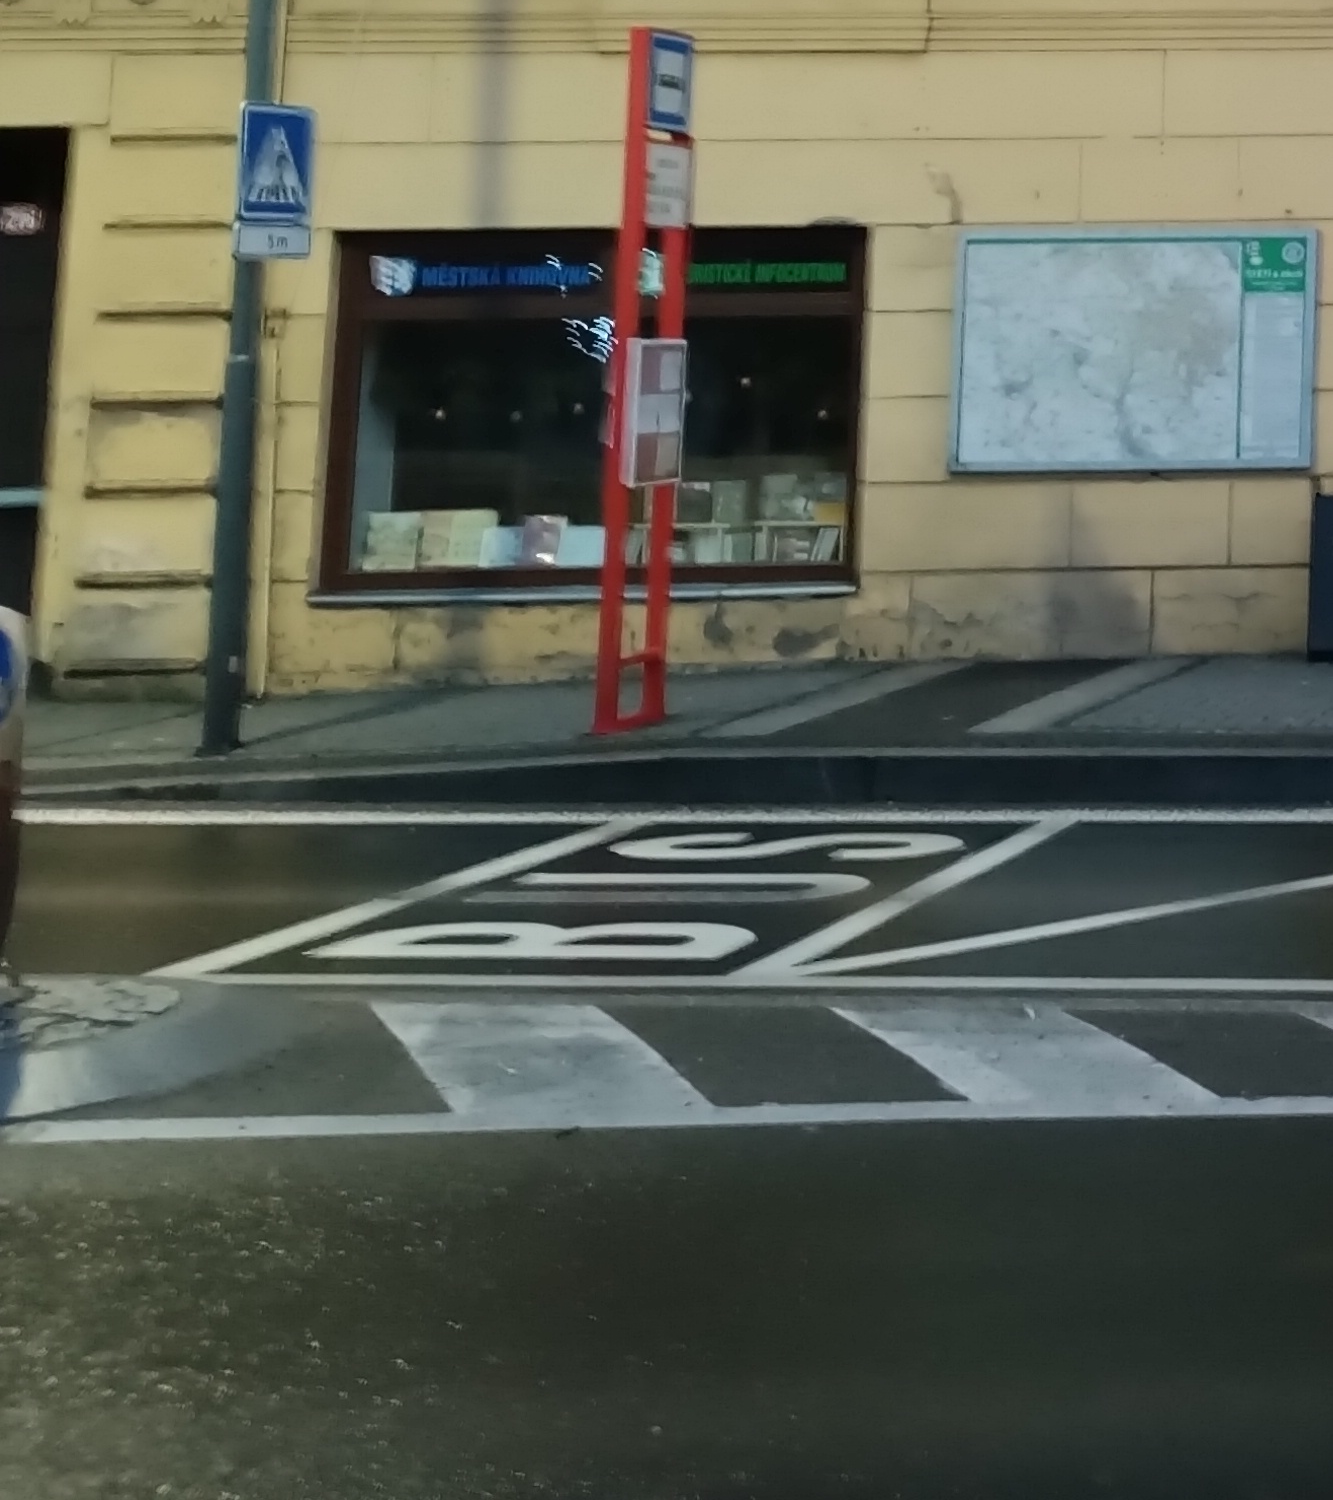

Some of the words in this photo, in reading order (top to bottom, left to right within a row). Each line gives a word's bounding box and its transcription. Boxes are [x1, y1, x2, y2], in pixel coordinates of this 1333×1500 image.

[421, 263, 500, 288] MĚSTSKÁ
[506, 263, 591, 288] KNIHOVNA
[755, 262, 847, 283] INFOCENTRUM
[302, 831, 967, 961] BUS
